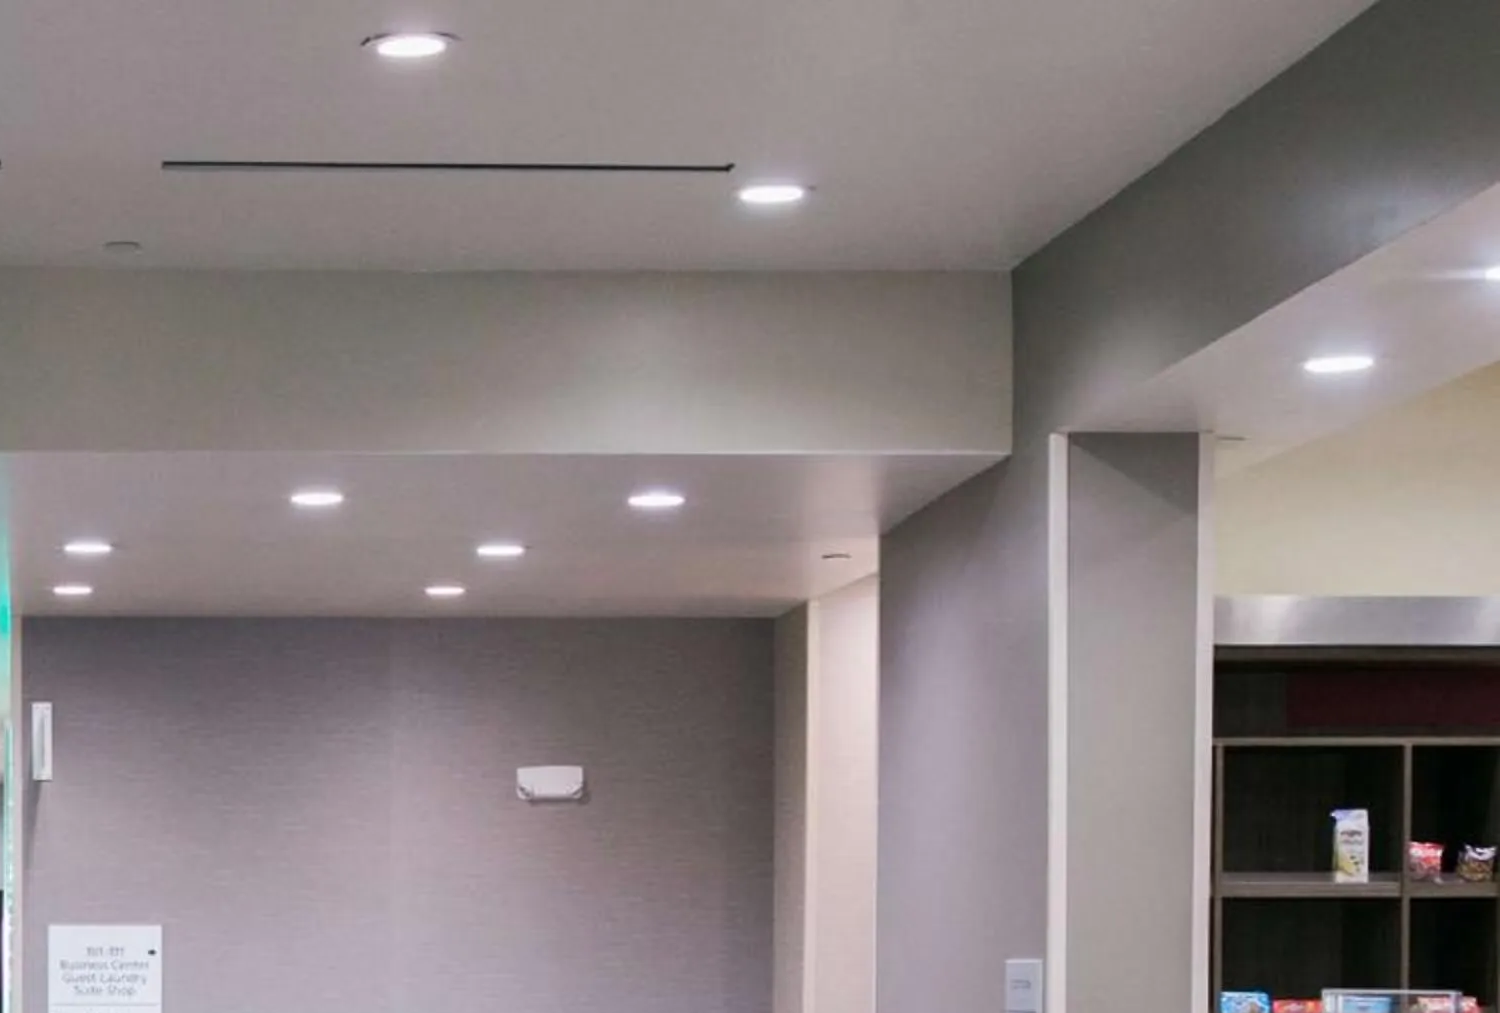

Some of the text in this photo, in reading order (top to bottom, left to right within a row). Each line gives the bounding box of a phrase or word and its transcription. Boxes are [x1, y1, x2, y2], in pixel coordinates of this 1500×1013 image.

[59, 959, 149, 970] Business Center
[61, 971, 147, 985] Guest Laundry
